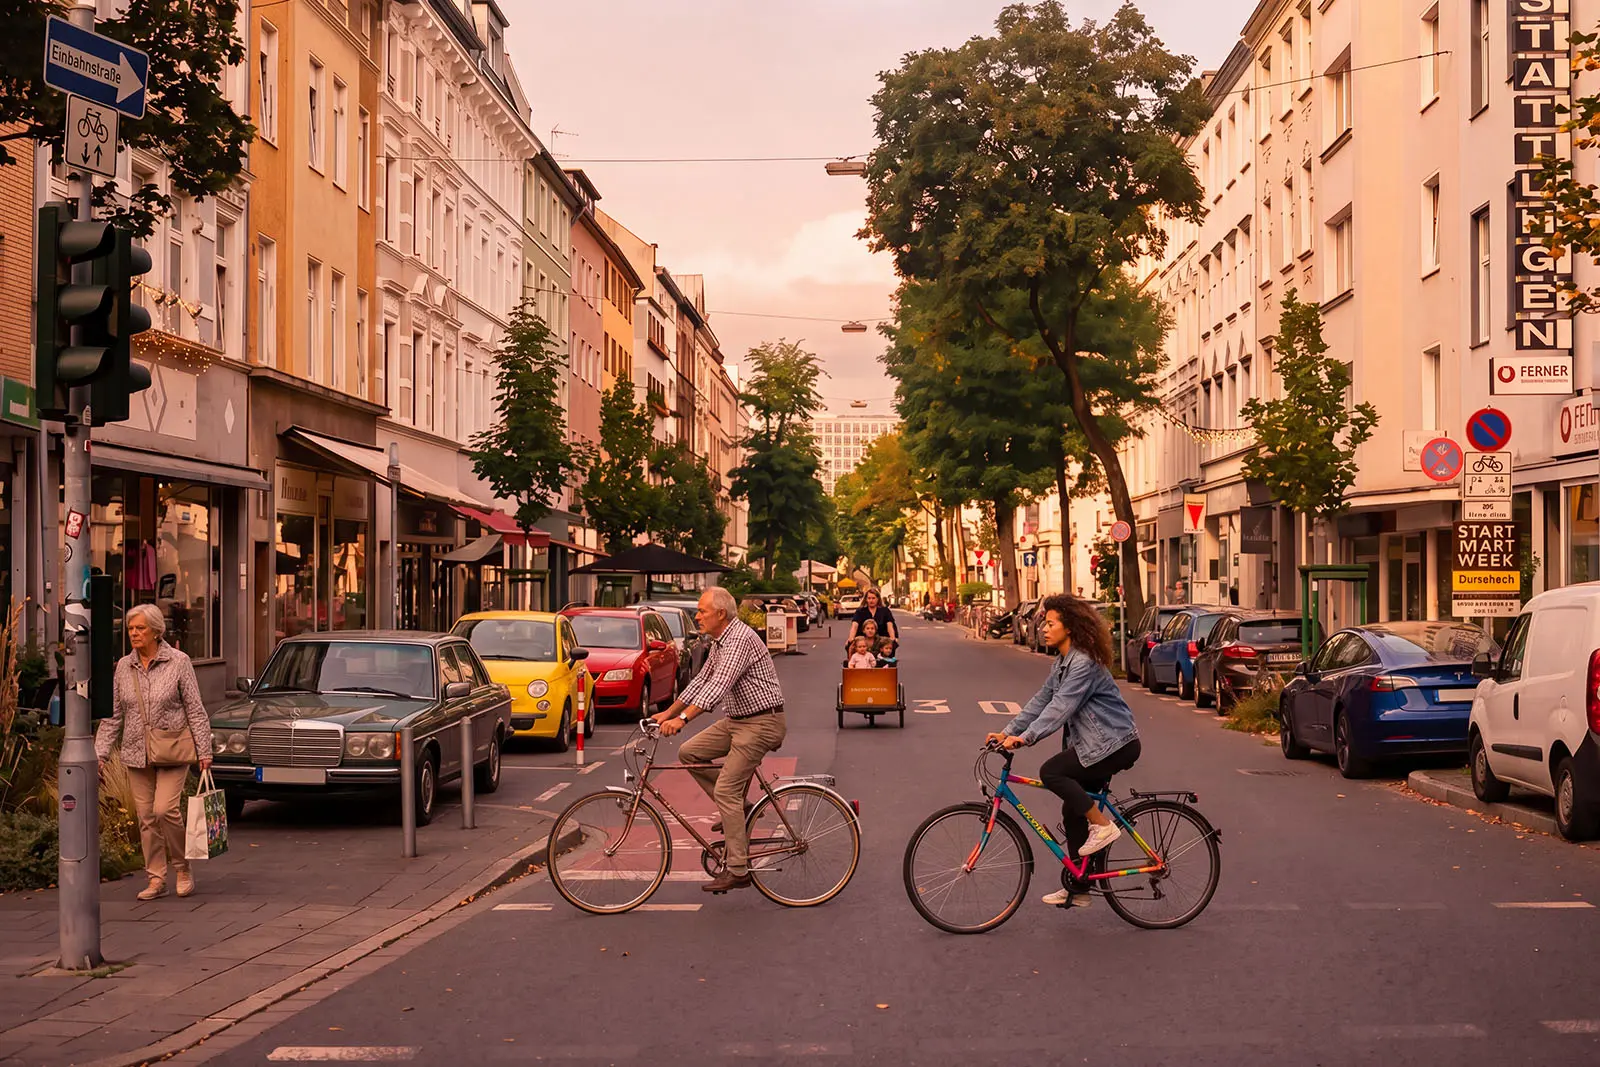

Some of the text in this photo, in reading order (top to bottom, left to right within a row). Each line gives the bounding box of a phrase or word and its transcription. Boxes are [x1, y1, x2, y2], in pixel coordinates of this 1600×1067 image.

[52, 45, 121, 84] Einbahnstraße
[1520, 365, 1568, 377] FERNER
[1458, 525, 1515, 538] START
[1460, 540, 1515, 552] MART
[1457, 554, 1513, 567] WEEK
[912, 699, 1022, 715] 30
